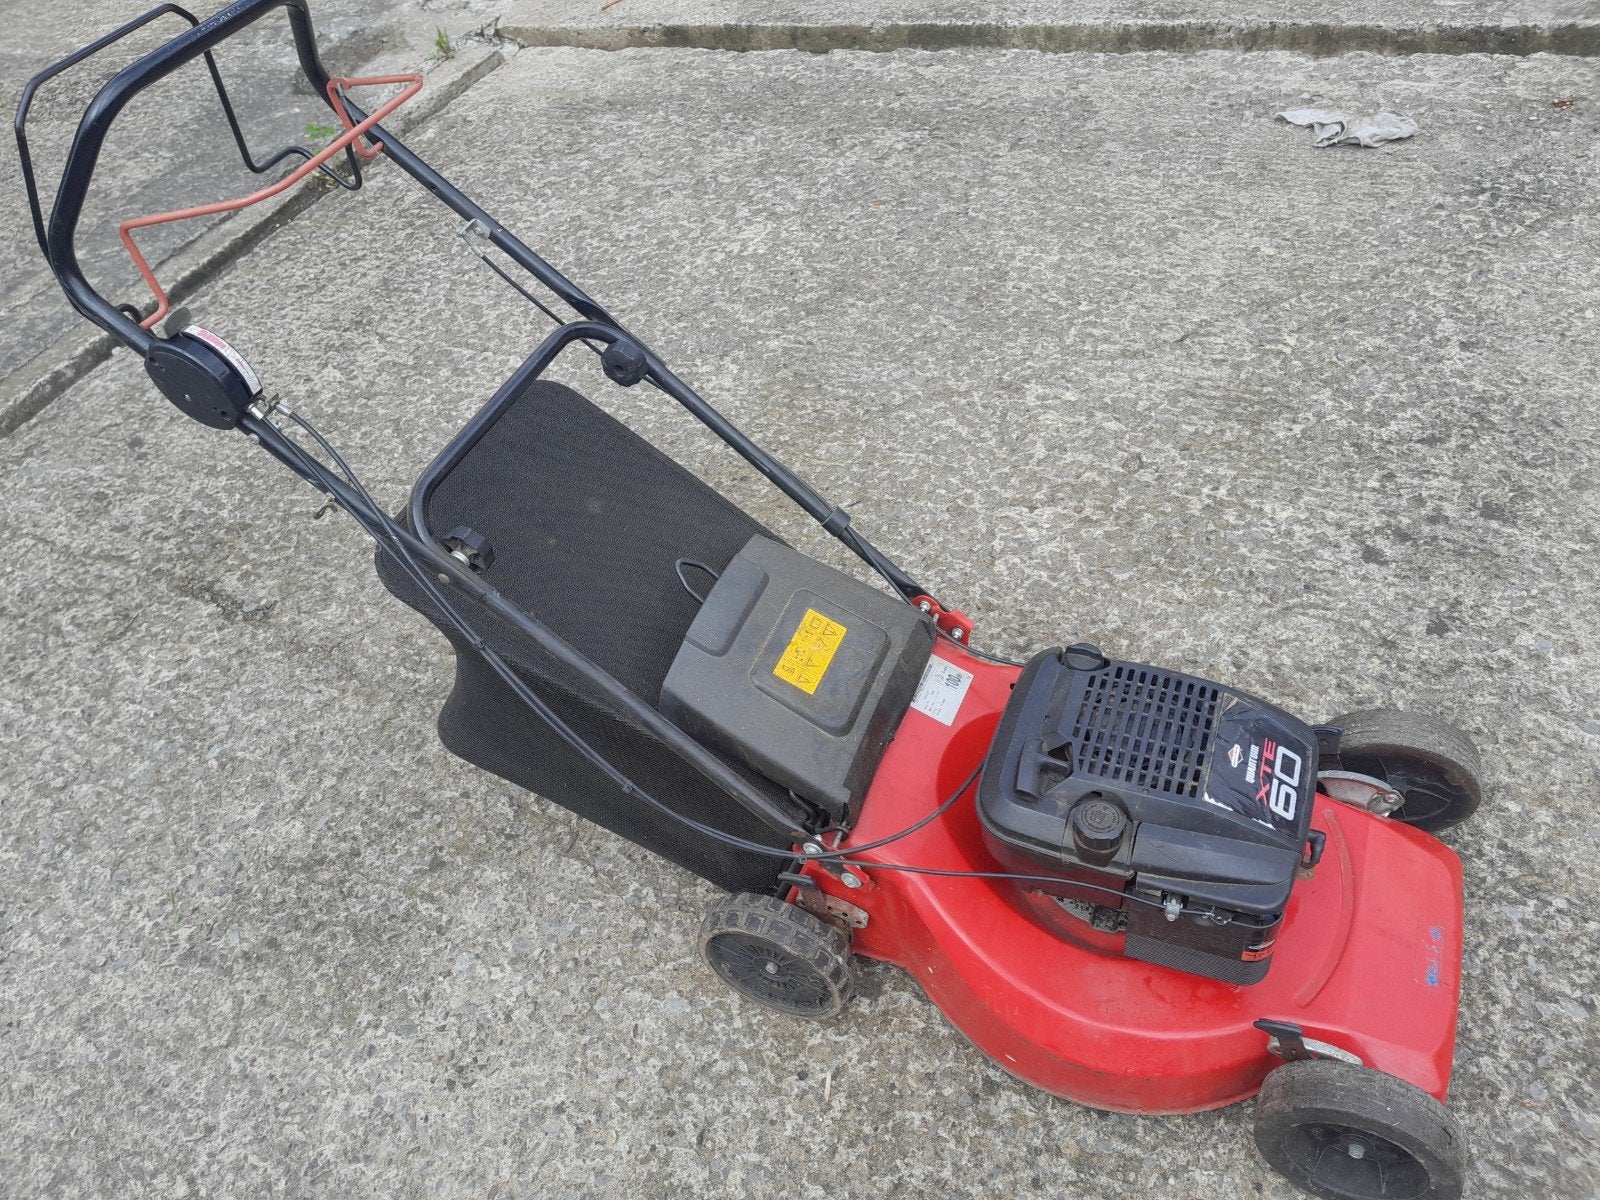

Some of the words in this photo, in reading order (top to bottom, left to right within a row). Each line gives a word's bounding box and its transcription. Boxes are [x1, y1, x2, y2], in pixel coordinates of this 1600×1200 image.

[945, 674, 961, 690] 100
[1245, 744, 1260, 784] QUANTUM
[1255, 737, 1276, 807] XTE
[1269, 745, 1302, 821] 60
